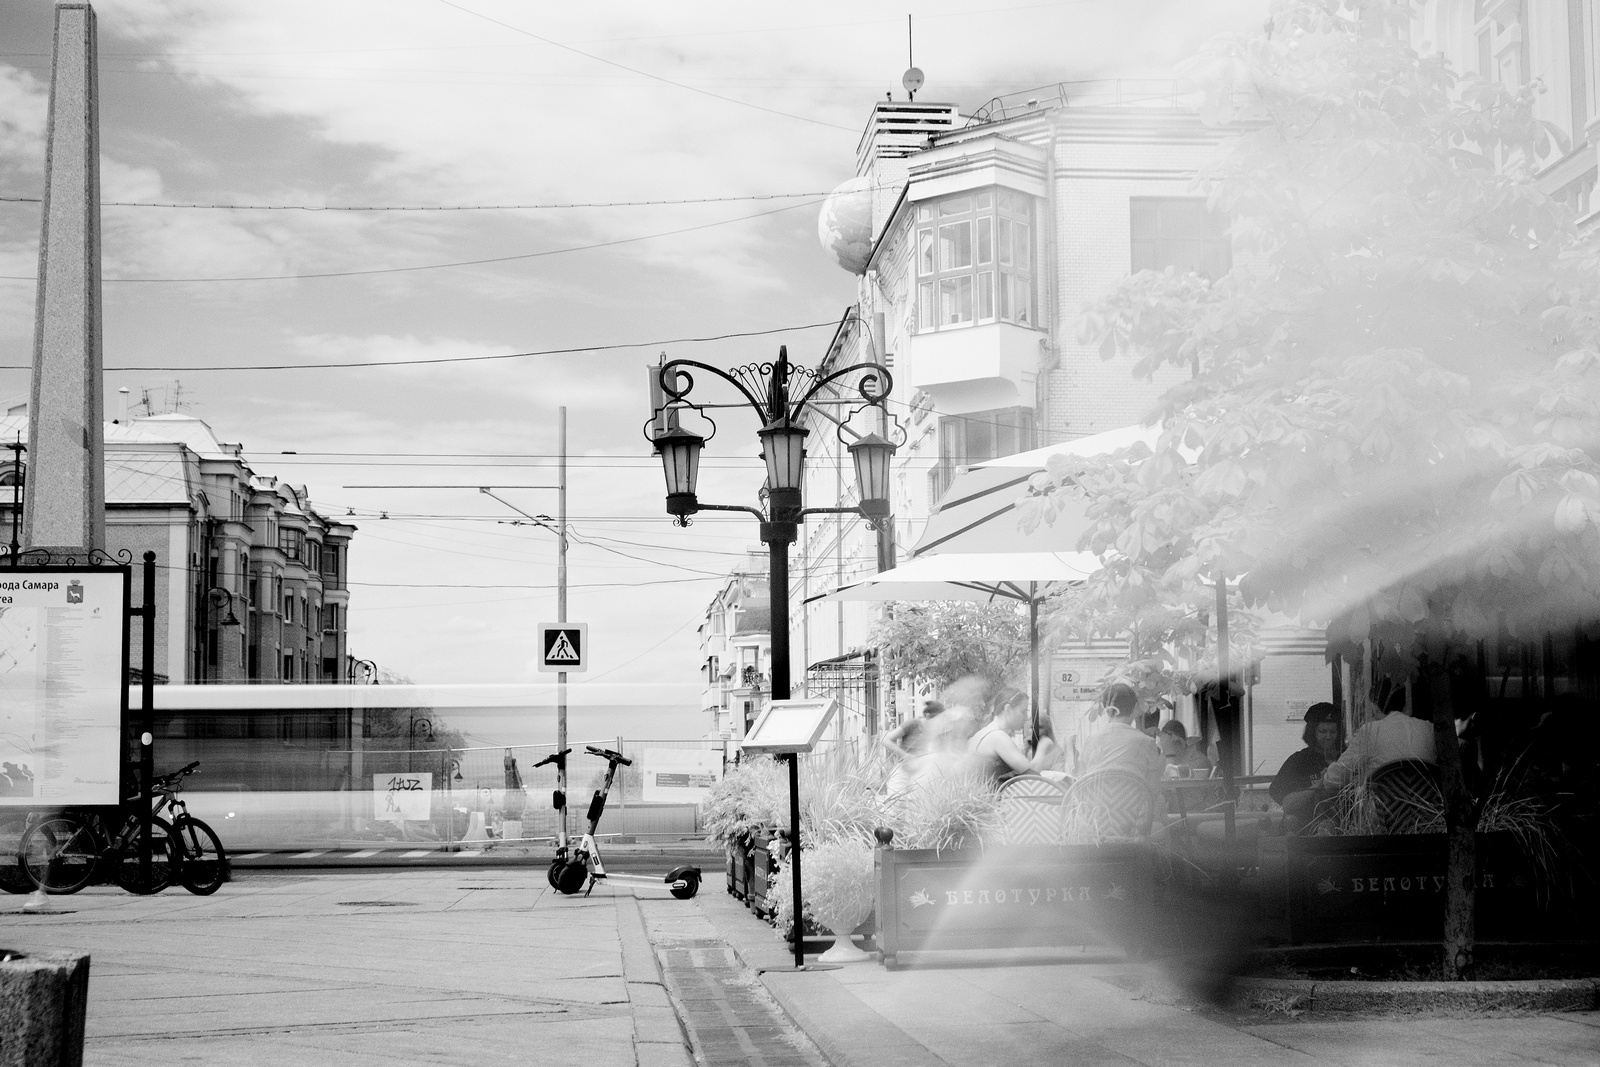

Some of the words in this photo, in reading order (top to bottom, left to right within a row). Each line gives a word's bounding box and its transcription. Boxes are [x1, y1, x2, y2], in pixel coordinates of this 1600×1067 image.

[0, 582, 20, 591] ода
[22, 579, 59, 592] Самара
[1062, 673, 1072, 682] 82
[1351, 873, 1495, 893] БЕЛОТУА
[945, 886, 1091, 906] БЕЛОТУРКА
